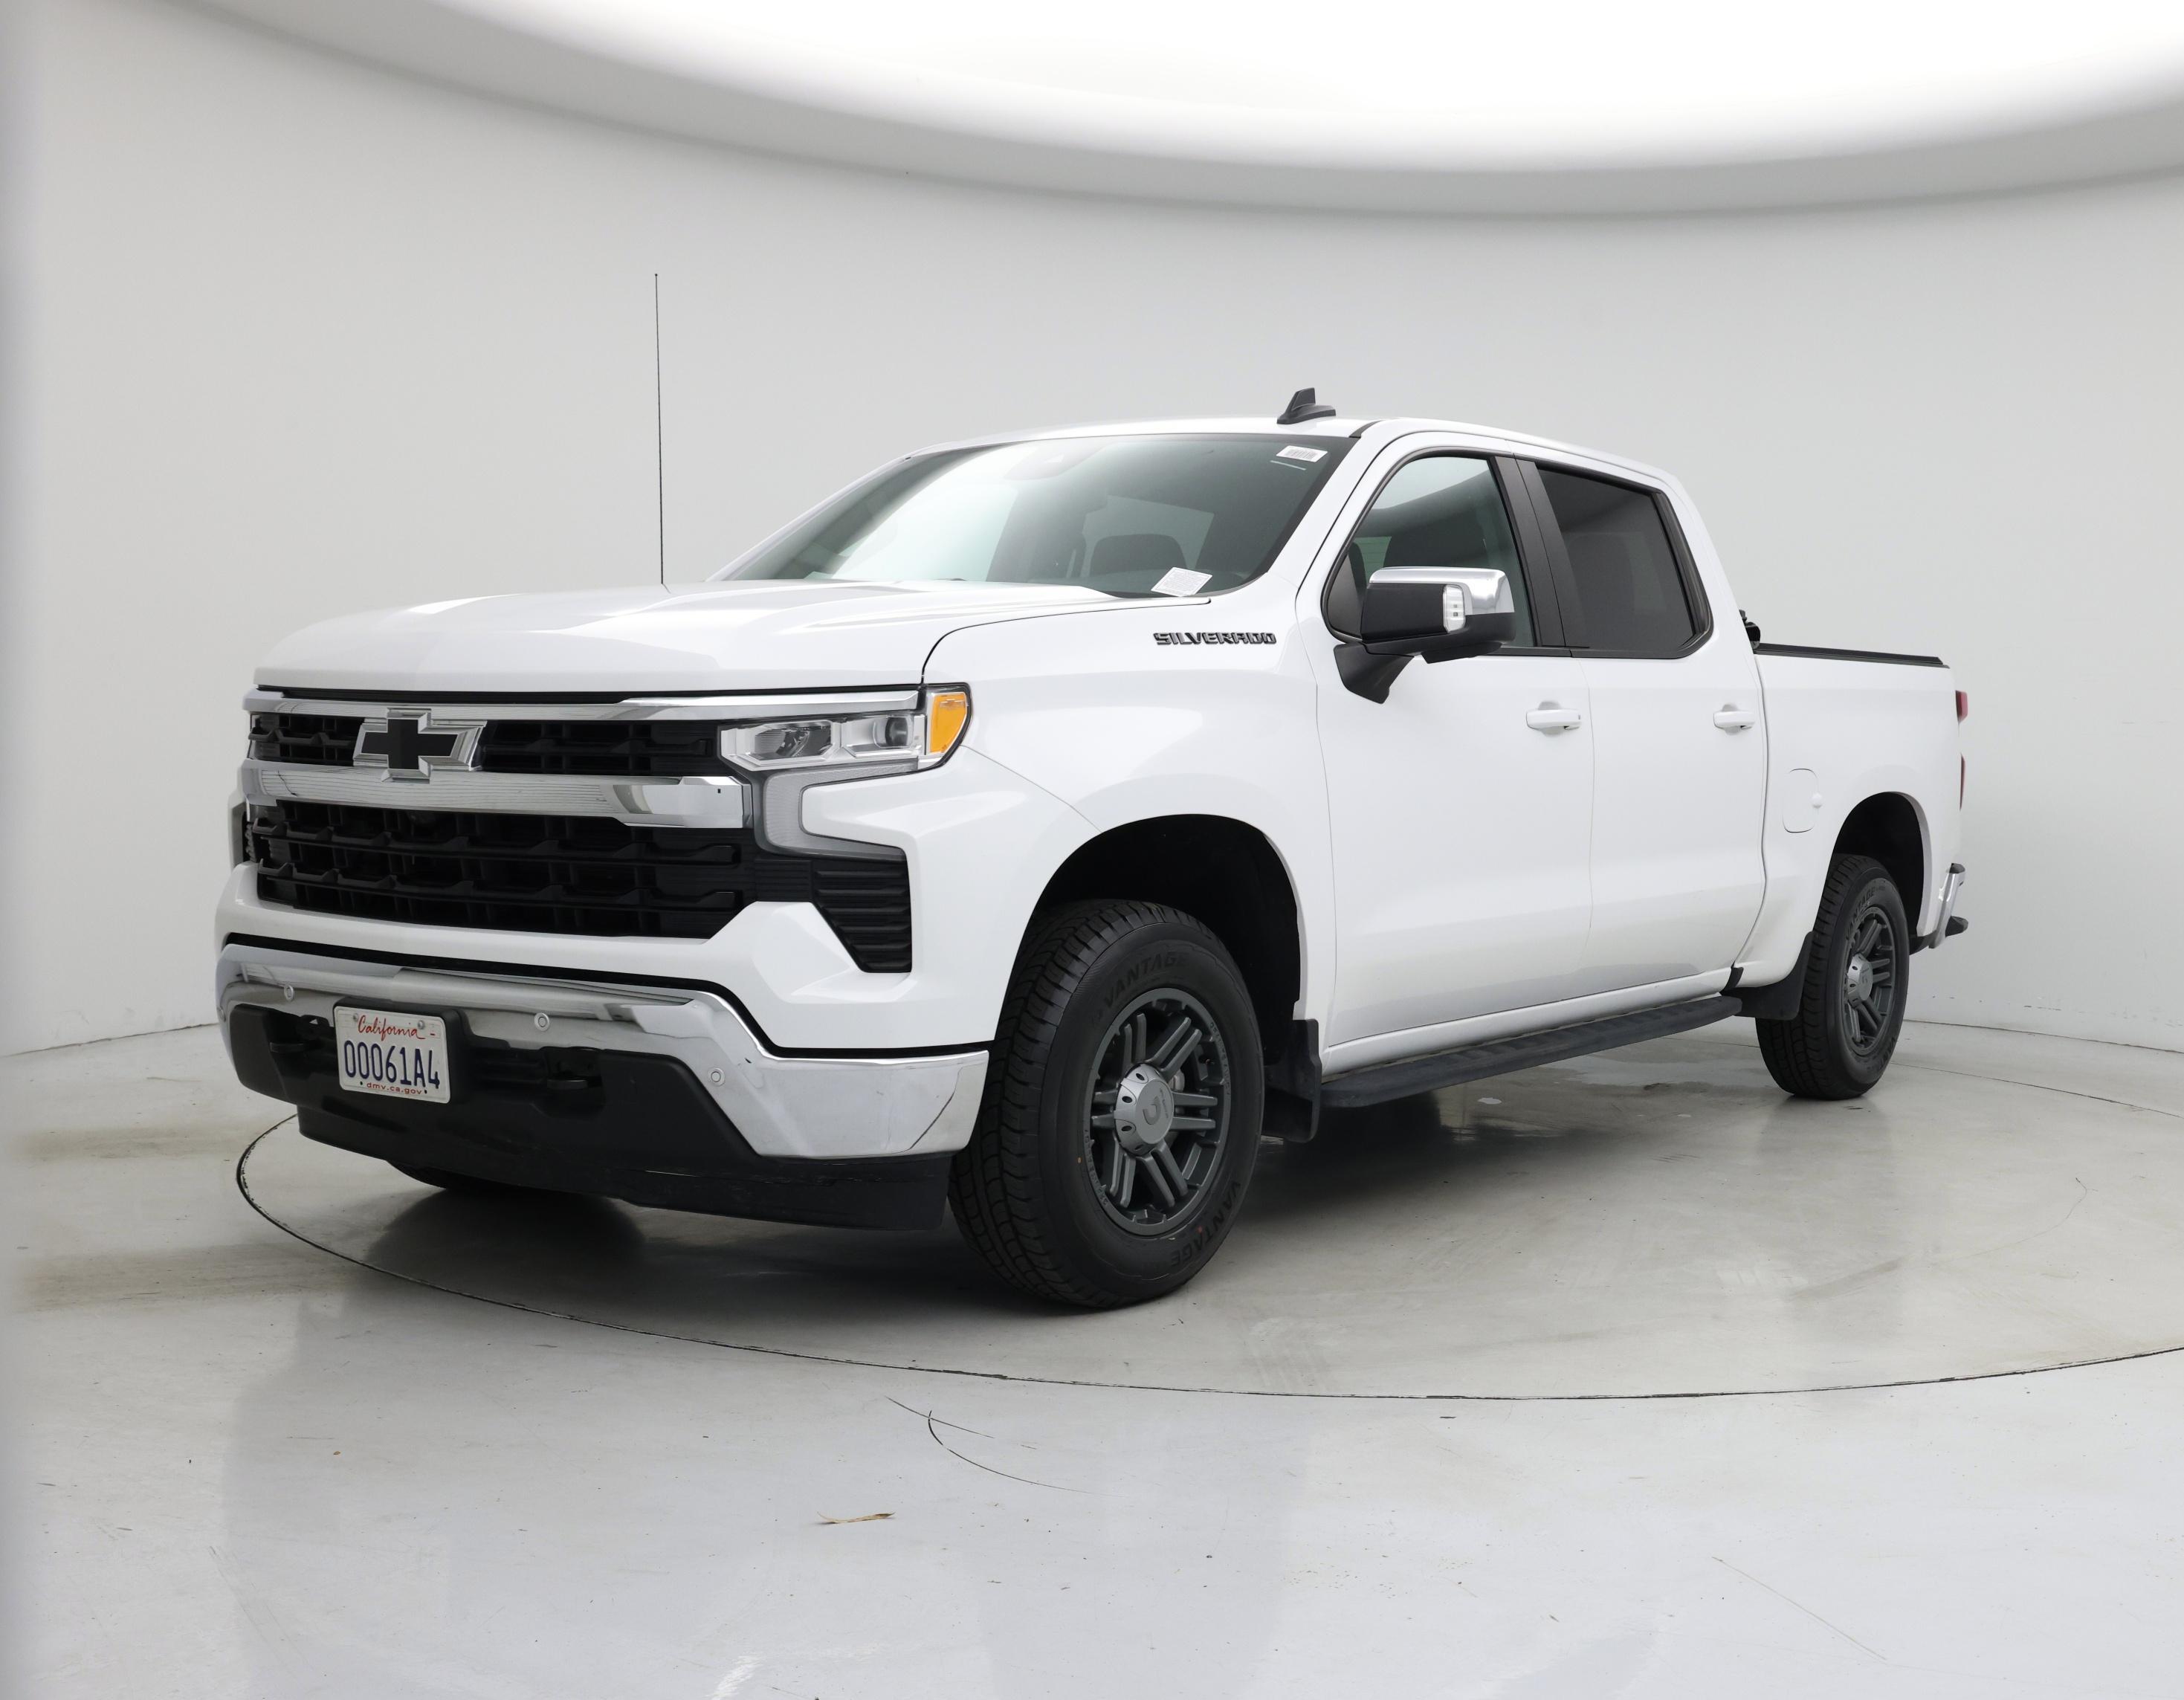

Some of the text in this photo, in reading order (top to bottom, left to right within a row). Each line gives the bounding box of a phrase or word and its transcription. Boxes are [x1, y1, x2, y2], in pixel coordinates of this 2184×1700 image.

[1154, 632, 1276, 645] SILVERADO
[358, 1014, 426, 1041] California
[343, 1040, 441, 1090] 00061A4
[366, 1082, 422, 1095] dmv.ca.gov
[1171, 1180, 1241, 1267] VANTAGE
